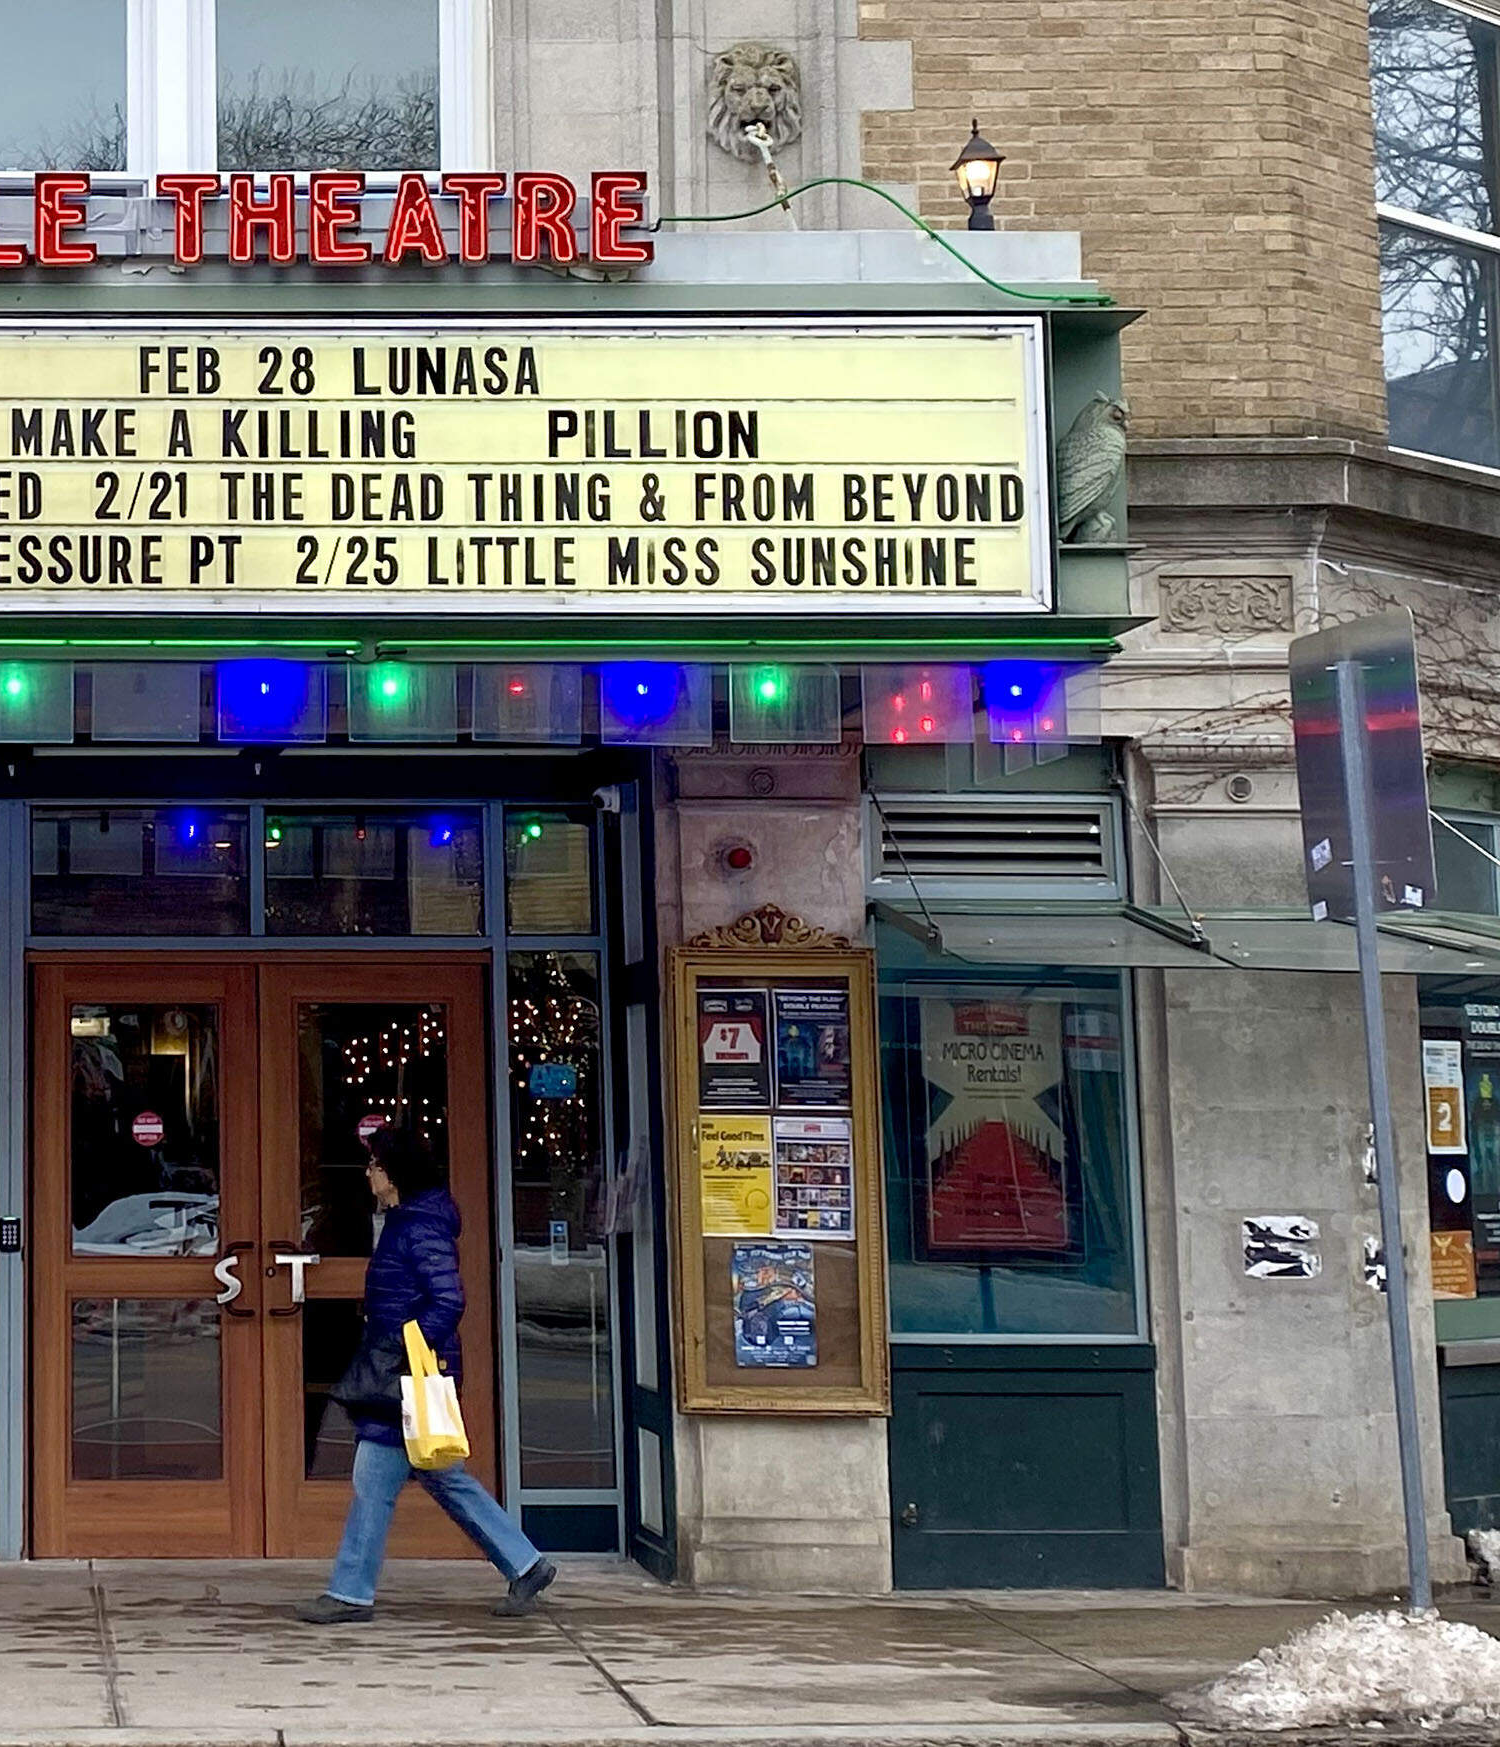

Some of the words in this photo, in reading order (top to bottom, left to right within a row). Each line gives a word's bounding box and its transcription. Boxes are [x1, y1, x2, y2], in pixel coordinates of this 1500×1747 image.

[156, 172, 655, 266] THEATRE
[139, 346, 221, 395] FEB
[258, 346, 315, 395] 28
[353, 346, 539, 395] LUNASA
[11, 408, 137, 458] MAKE
[168, 408, 193, 458] A
[222, 408, 416, 458] KILLING
[548, 408, 759, 458] PILLION
[95, 470, 187, 522] 2/21
[221, 470, 304, 522] THE
[331, 470, 444, 522] DEAD
[467, 470, 611, 522] THING
[639, 470, 666, 522] &
[695, 470, 814, 522] FROM
[843, 470, 1024, 522] BEYOND
[189, 534, 242, 586] PT
[295, 534, 399, 586] 2/25
[428, 534, 576, 586] LITTLE
[608, 534, 720, 586] MISS
[751, 534, 977, 586] SUNSHINE
[942, 1042, 987, 1060] MICRO
[990, 1042, 1045, 1061] CINEMA
[967, 1064, 1021, 1082] Rentals!
[701, 1131, 719, 1141] Feel
[720, 1131, 743, 1141] Good
[1436, 1101, 1453, 1132] 2
